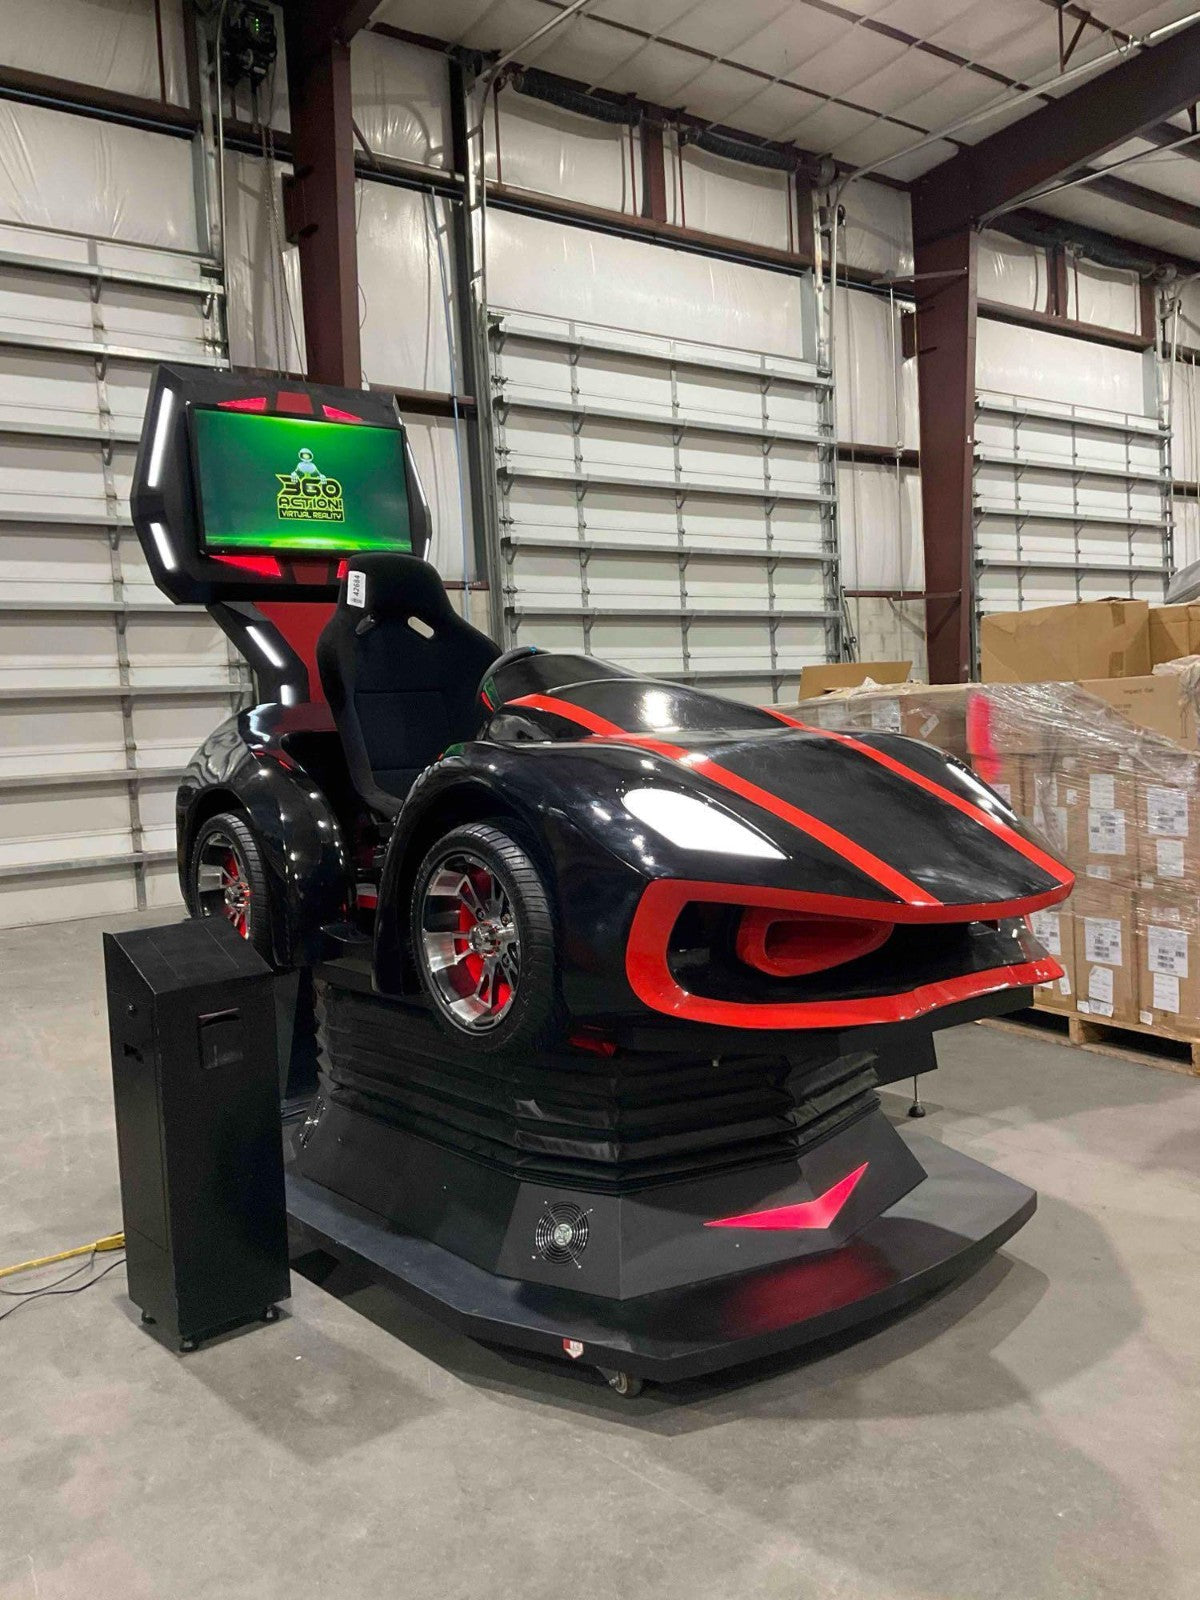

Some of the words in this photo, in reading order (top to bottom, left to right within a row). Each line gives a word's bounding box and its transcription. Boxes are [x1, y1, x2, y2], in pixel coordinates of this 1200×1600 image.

[276, 474, 342, 499] 360
[279, 498, 342, 510] ACTION!
[281, 510, 311, 518] VIRTUAL
[313, 511, 342, 519] REALITY
